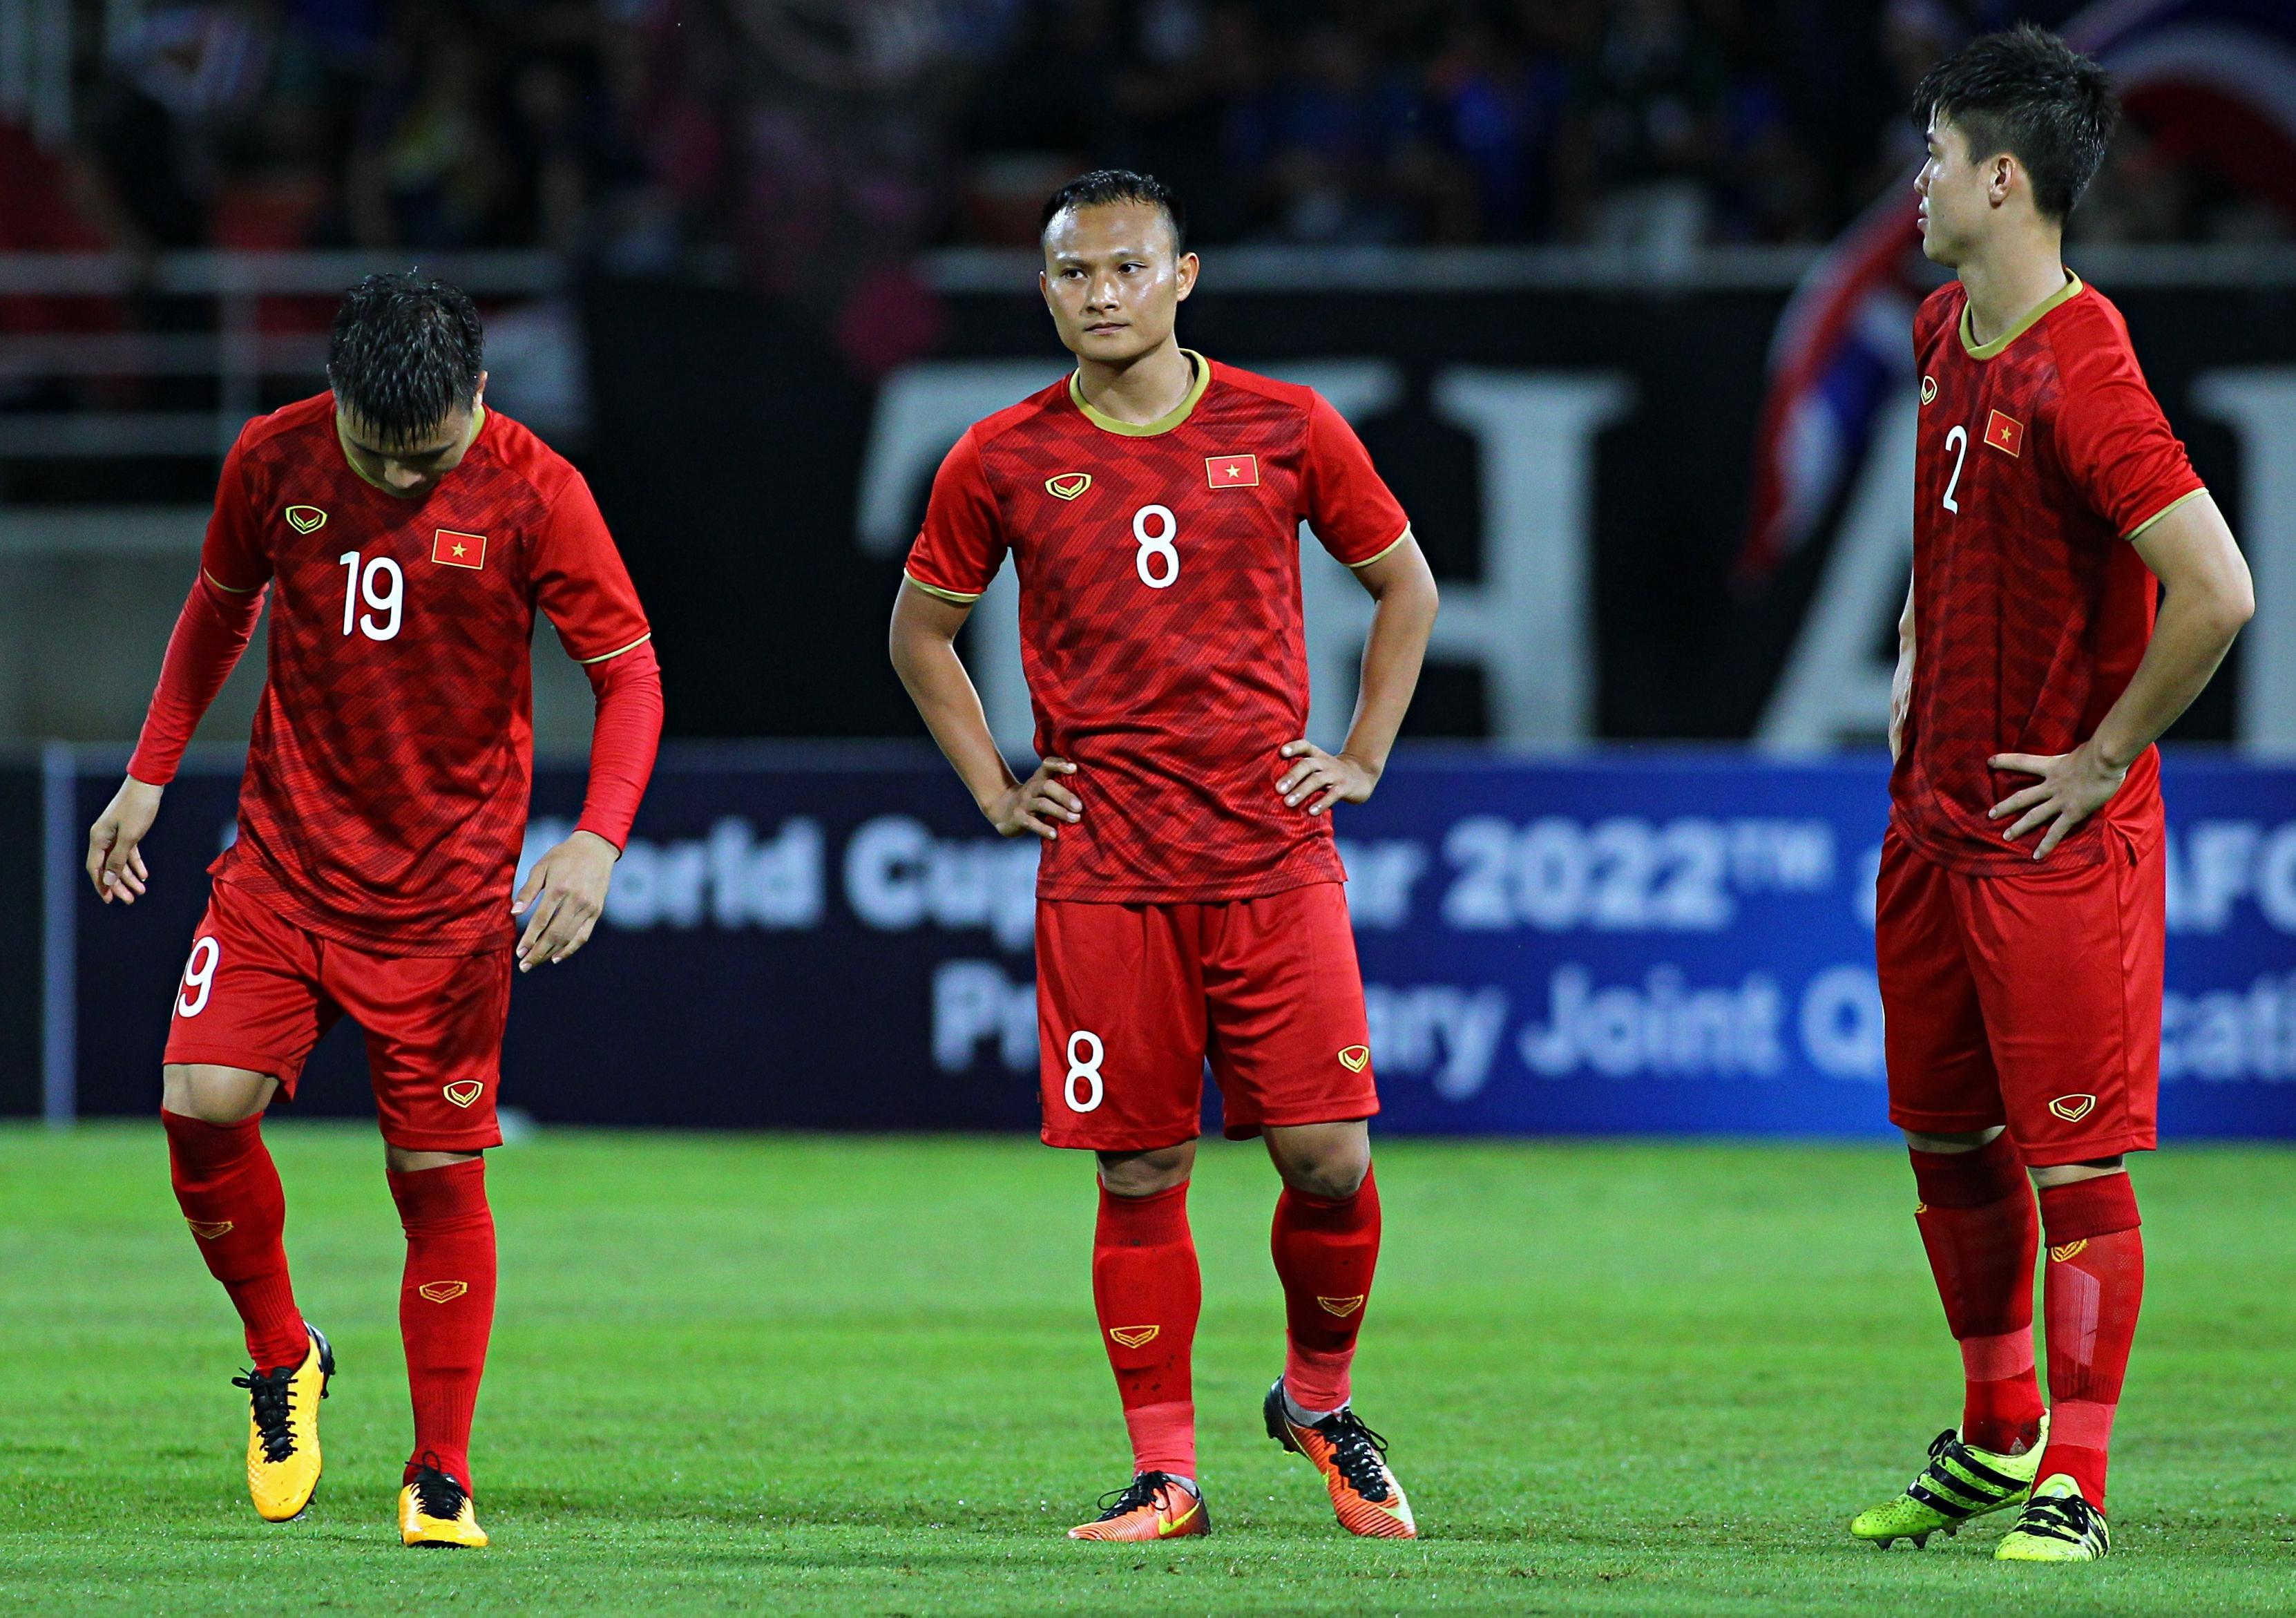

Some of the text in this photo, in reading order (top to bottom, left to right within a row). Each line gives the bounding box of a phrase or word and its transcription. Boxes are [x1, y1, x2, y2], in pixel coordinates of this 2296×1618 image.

[1942, 425, 1968, 515] 2
[1132, 504, 1180, 589] 8
[339, 551, 403, 641] 19
[171, 935, 220, 1018] 9
[1522, 966, 1787, 1078] Joint
[1064, 1030, 1104, 1113] 8
